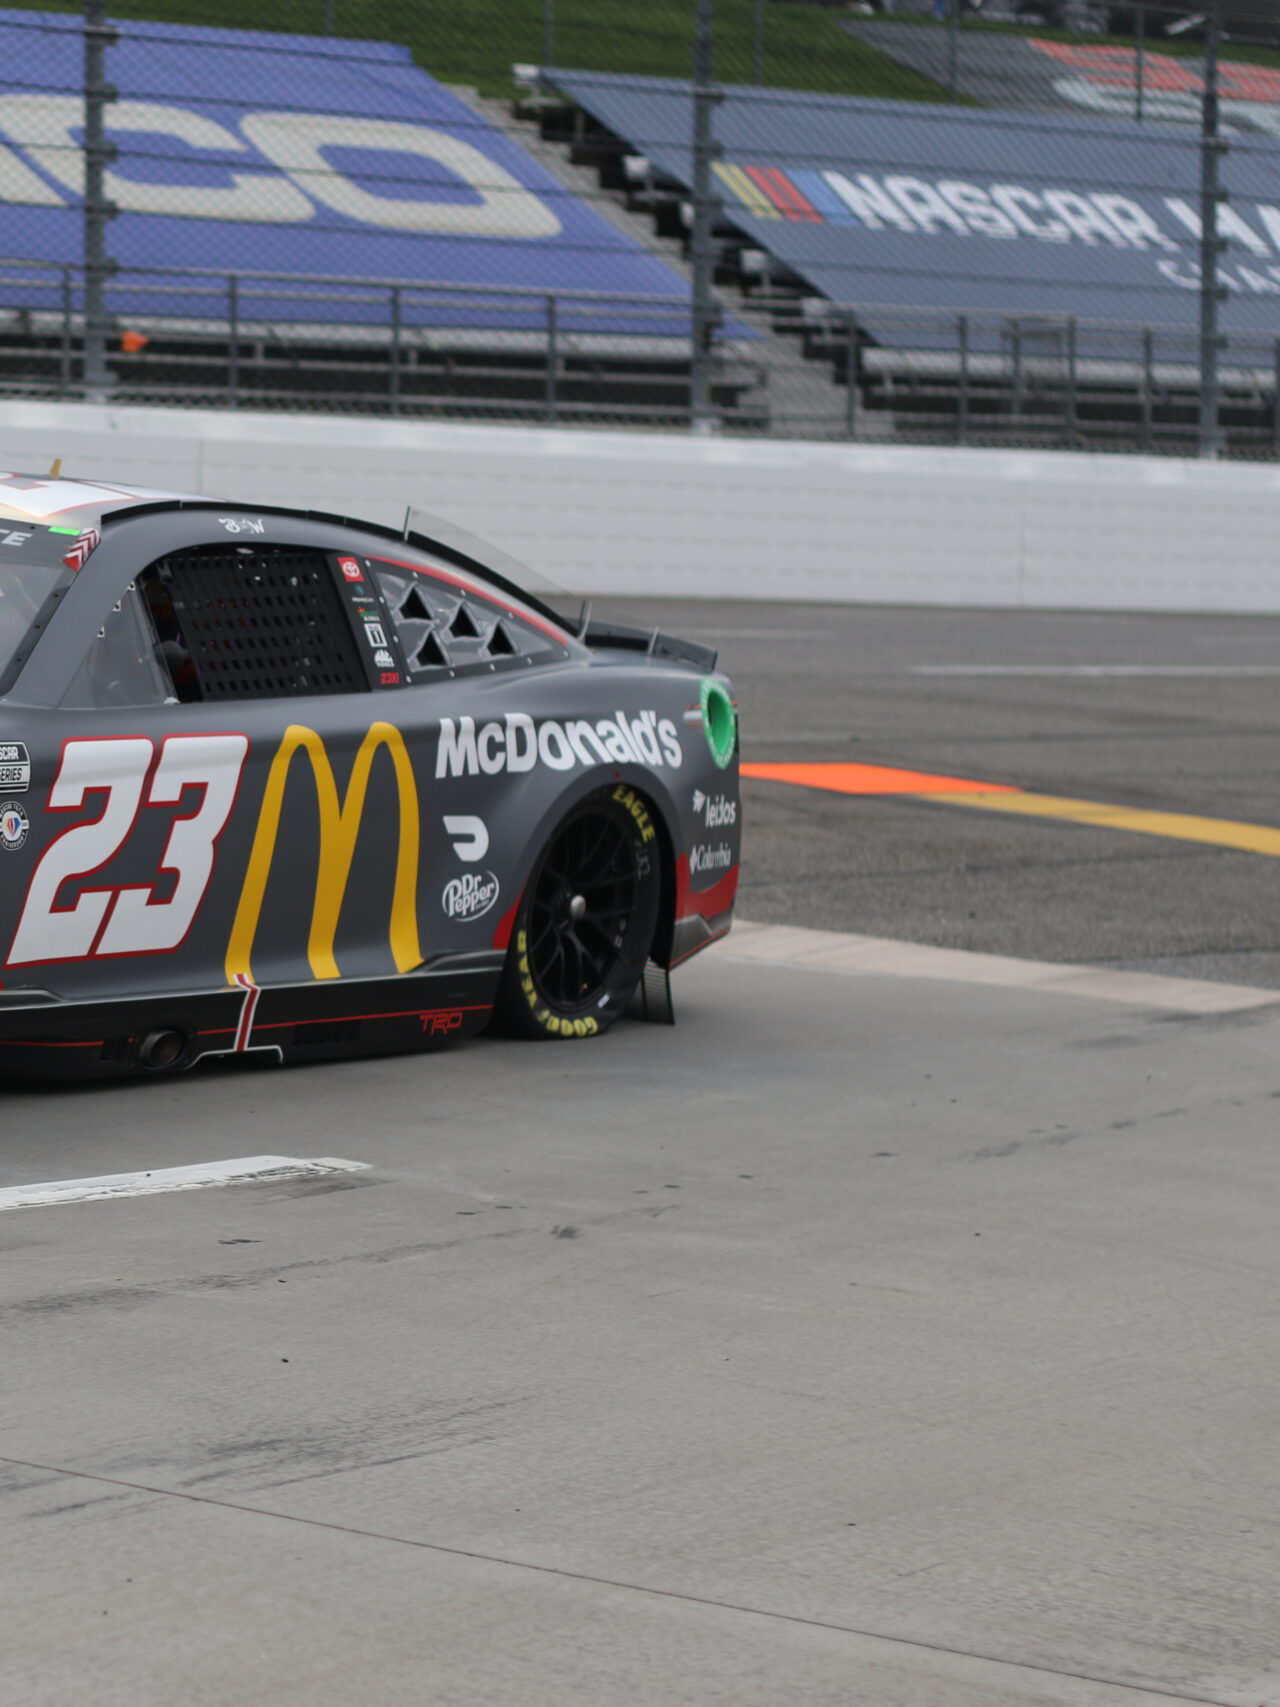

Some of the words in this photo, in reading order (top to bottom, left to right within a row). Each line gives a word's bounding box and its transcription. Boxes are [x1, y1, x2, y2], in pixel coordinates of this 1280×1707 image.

[822, 169, 1182, 254] NASCAR
[435, 711, 683, 779] McDonald's
[612, 783, 656, 843] EAGLE
[705, 793, 737, 829] leidos
[3, 732, 250, 970] 23
[697, 842, 732, 872] Columbia
[442, 878, 495, 917] Pepper
[461, 873, 483, 895] Dr
[419, 1011, 464, 1035] TRD
